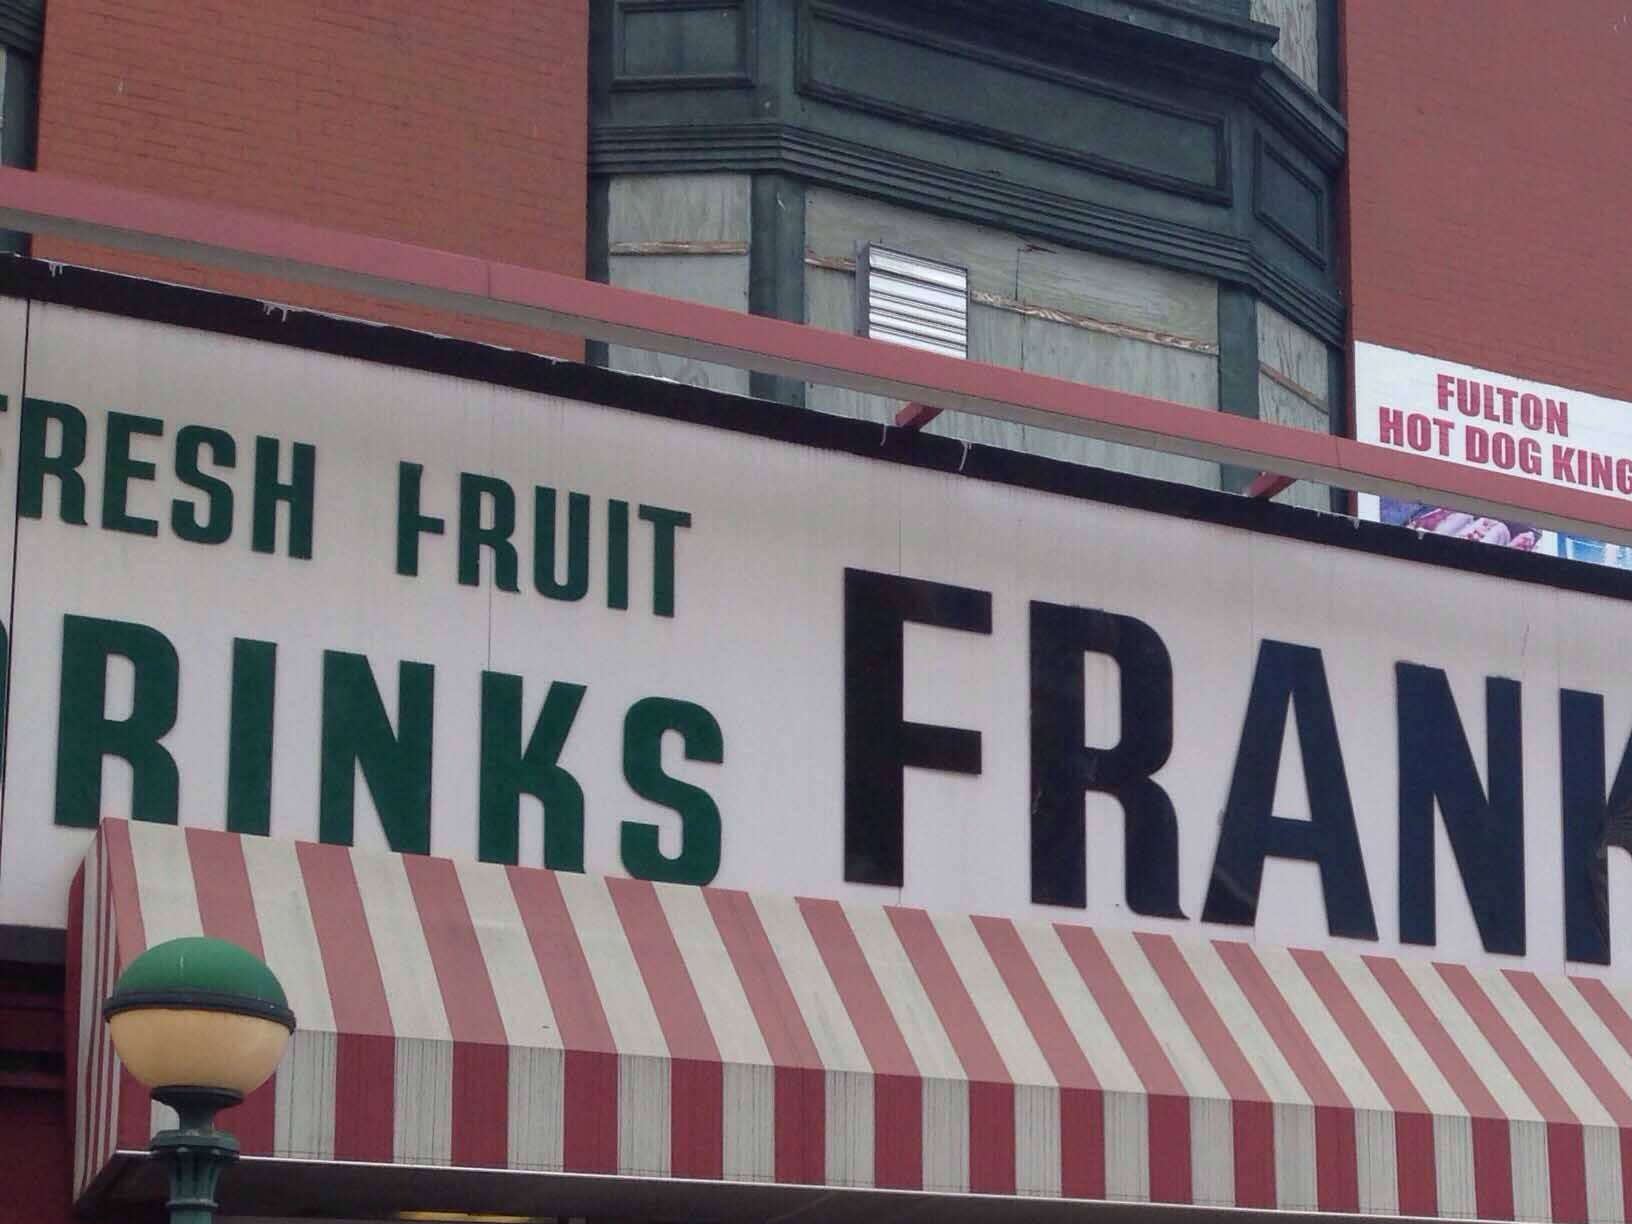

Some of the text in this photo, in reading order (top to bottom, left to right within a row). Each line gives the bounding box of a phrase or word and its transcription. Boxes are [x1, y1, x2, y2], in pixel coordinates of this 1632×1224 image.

[1378, 406, 1455, 457] HOT
[1465, 423, 1542, 477] DOG
[1436, 373, 1569, 438] FULTON
[0, 393, 693, 619] RESH FRUIT
[0, 612, 725, 887] RINKS
